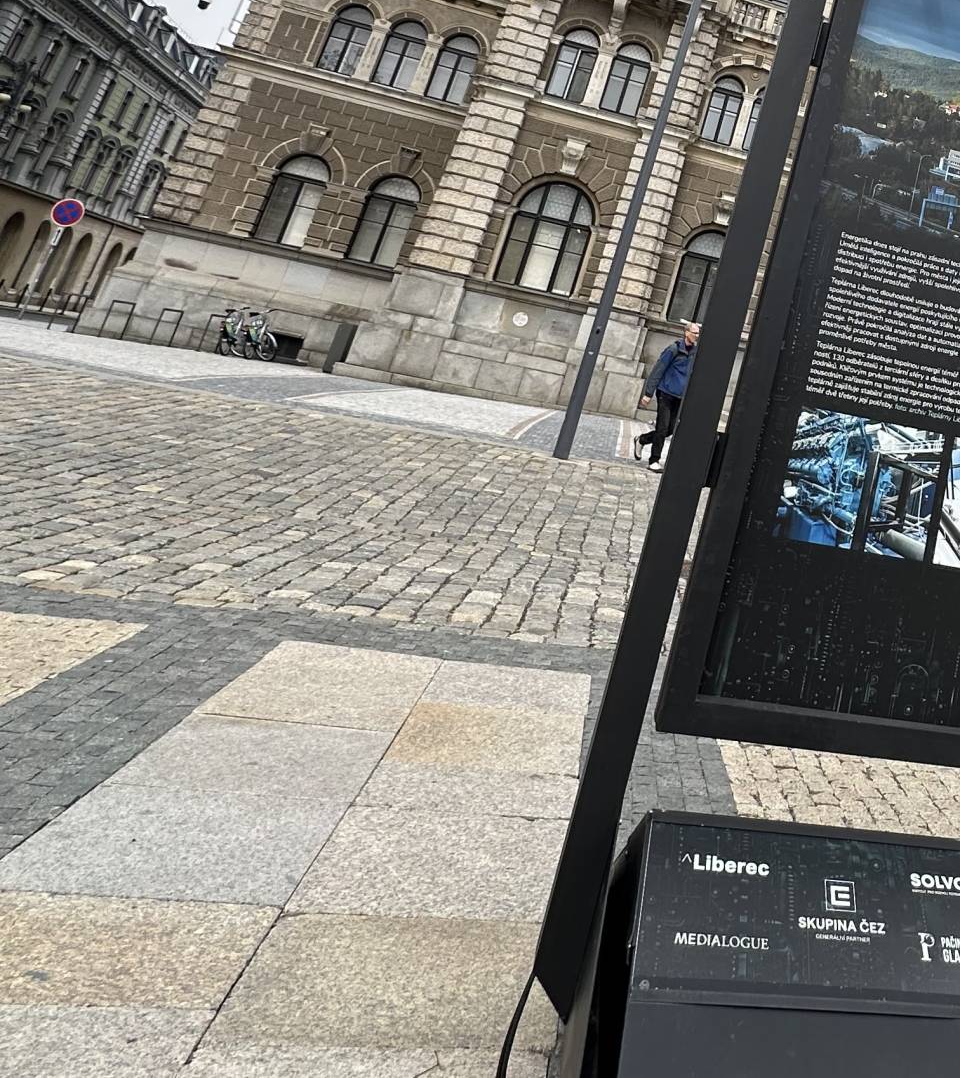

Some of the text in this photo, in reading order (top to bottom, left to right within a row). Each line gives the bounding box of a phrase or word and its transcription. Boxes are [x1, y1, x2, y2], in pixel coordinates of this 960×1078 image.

[798, 916, 886, 935] SKUPINA ČEZ
[674, 932, 769, 950] MEDIALOGUE
[815, 933, 870, 944] GENERÁLNÍ PARTNER
